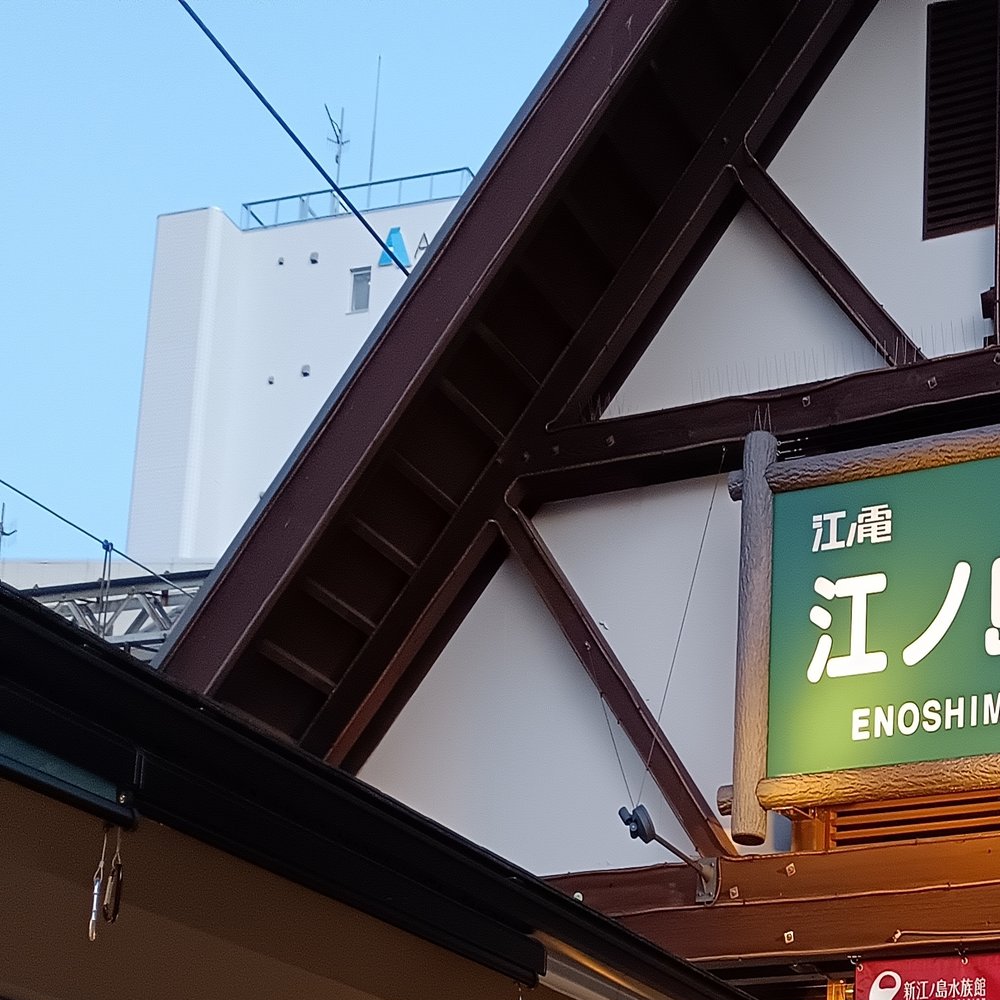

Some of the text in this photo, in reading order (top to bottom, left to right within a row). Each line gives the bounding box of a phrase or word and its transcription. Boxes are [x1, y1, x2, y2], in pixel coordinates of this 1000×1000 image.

[903, 977, 986, 1000] 新江ノ島水族館
